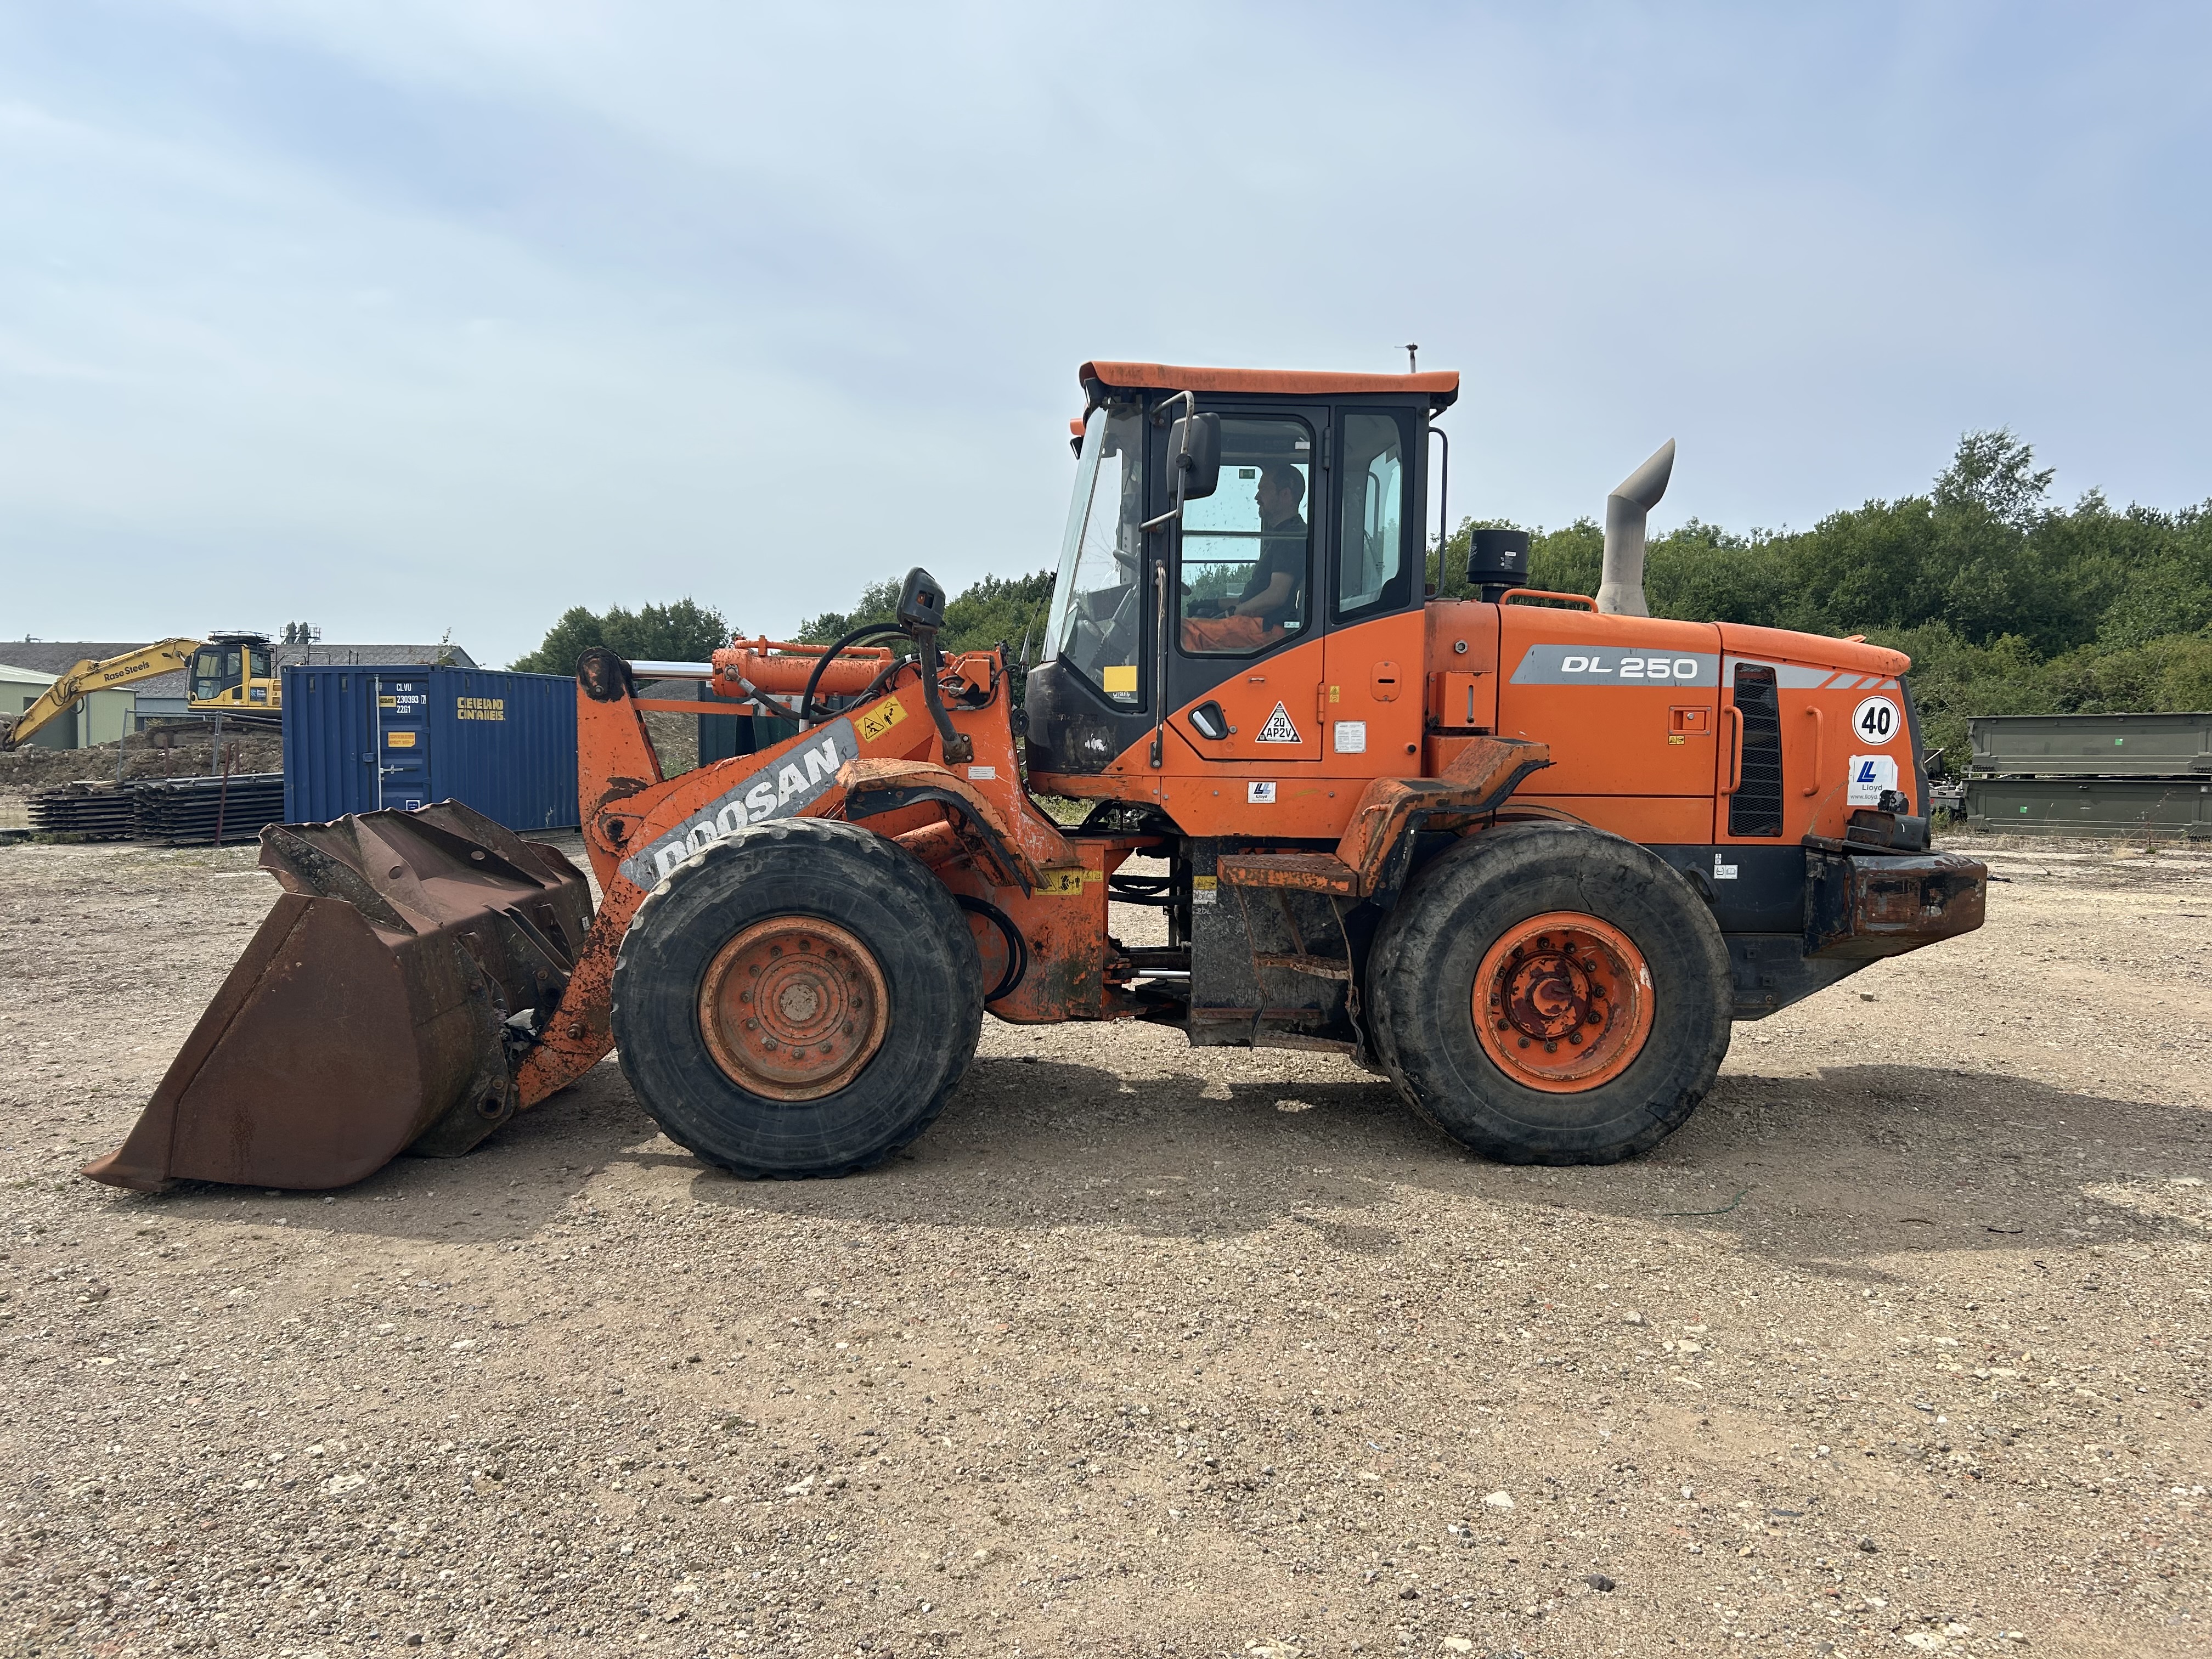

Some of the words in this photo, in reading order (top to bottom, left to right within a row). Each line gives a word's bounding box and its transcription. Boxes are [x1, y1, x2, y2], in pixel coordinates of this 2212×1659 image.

[125, 661, 150, 675] Steels
[1561, 656, 1613, 673] DL
[1620, 657, 1698, 679] 250
[396, 683, 411, 691] CLVU
[397, 695, 419, 703] 230393
[421, 695, 426, 704] 7
[1273, 717, 1285, 727] 20
[1861, 707, 1891, 735] 40
[1267, 728, 1291, 737] AP2V
[1862, 784, 1883, 792] Lloyd
[654, 737, 840, 878] DOOSAN
